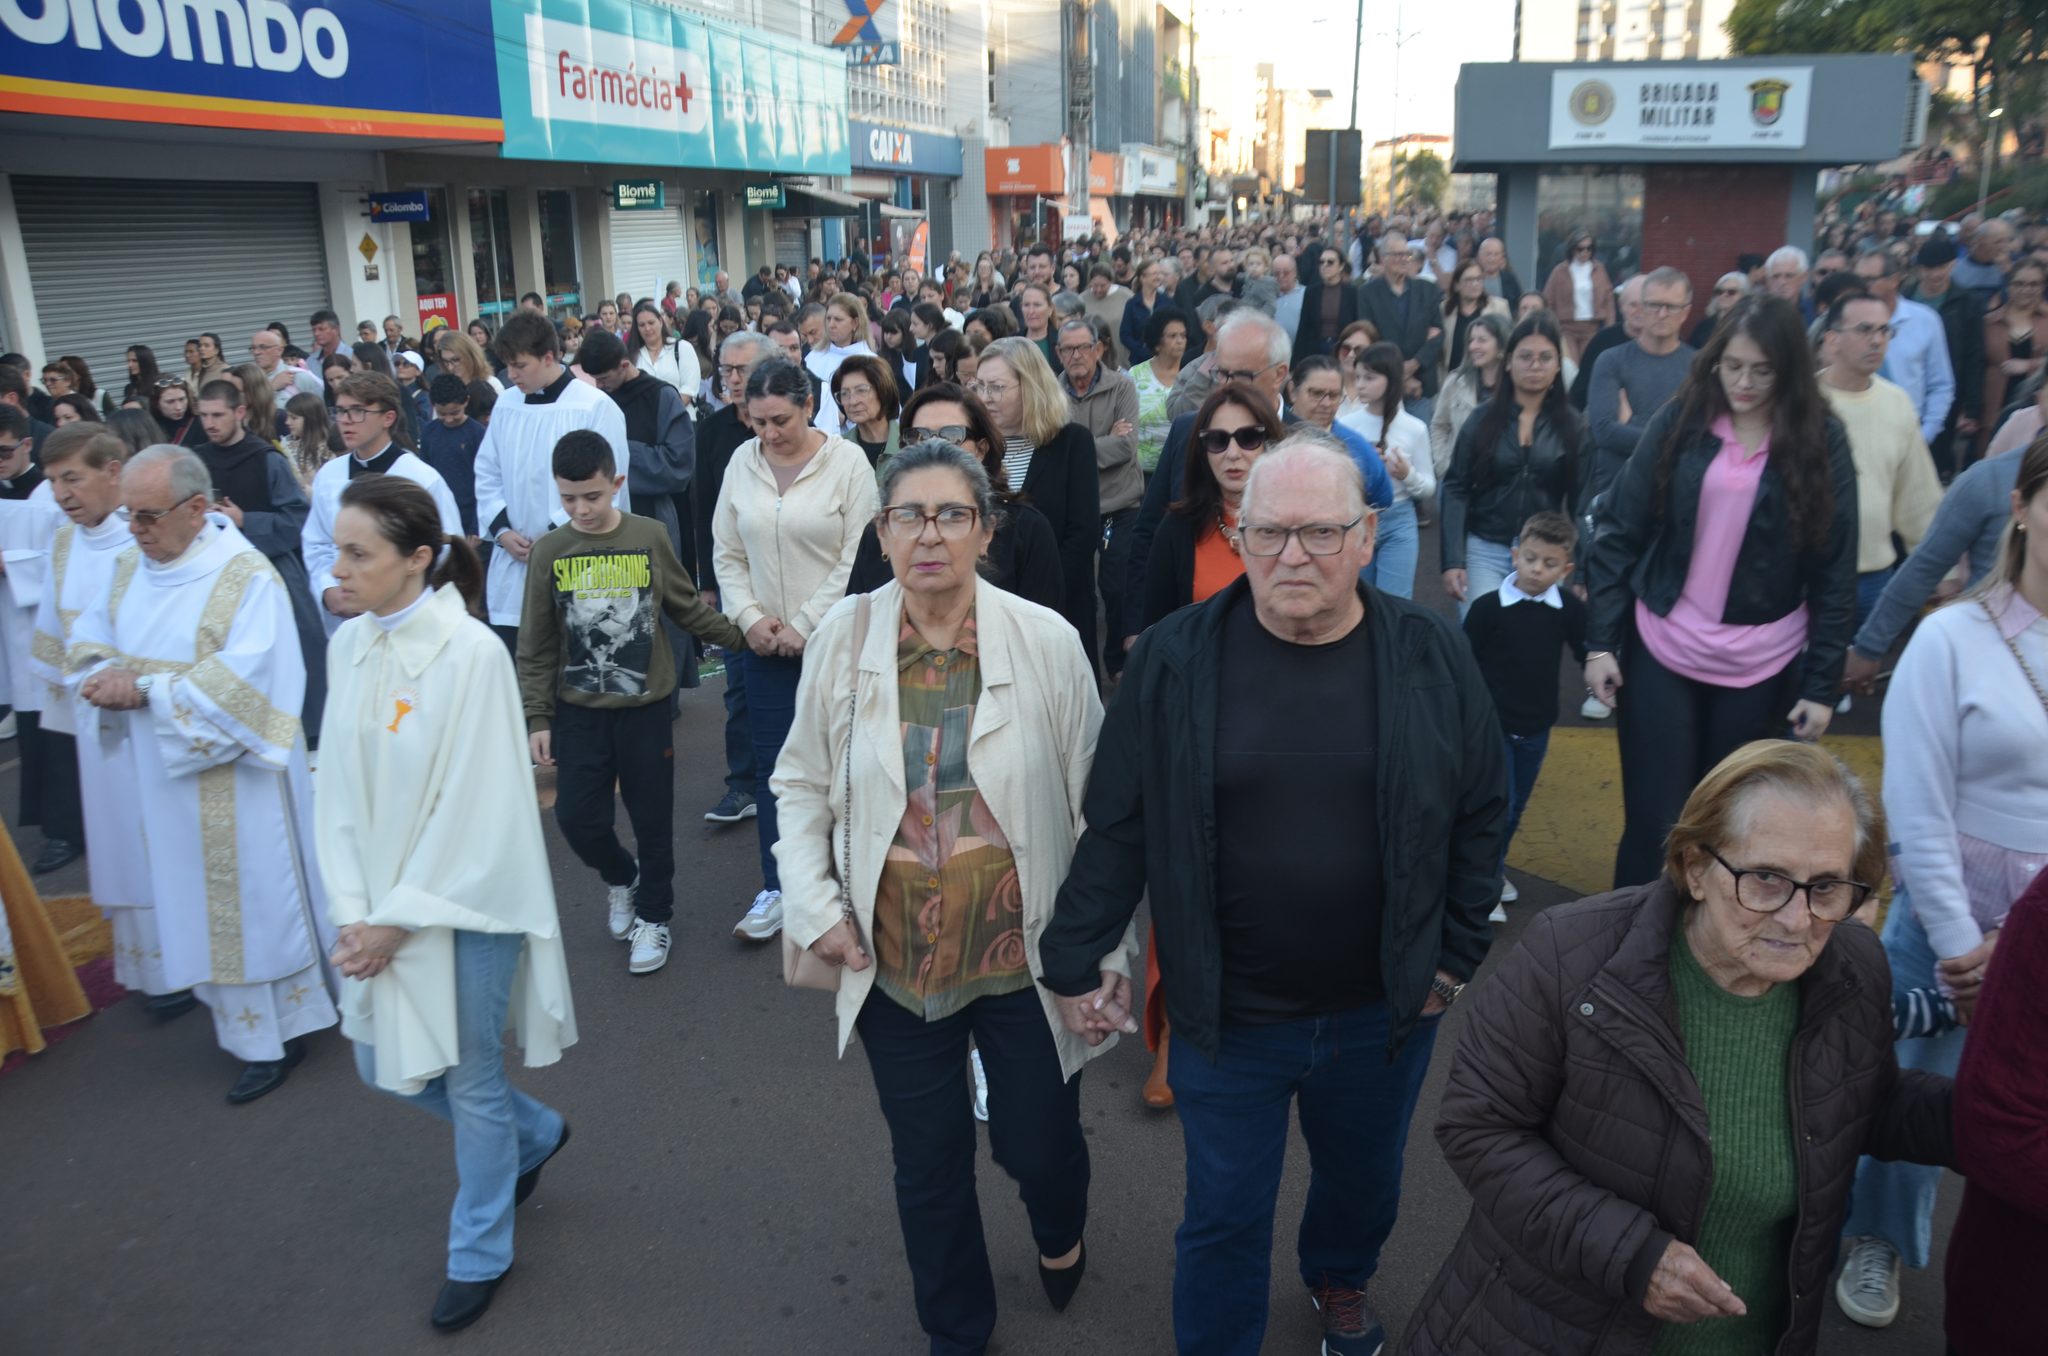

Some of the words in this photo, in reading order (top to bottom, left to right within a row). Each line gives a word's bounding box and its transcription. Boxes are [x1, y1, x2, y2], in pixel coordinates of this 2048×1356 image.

[1640, 82, 1719, 102] BRIGADA
[1640, 107, 1715, 127] MILITAR
[869, 128, 912, 165] CAIXA
[383, 202, 424, 213] Colombo
[419, 298, 434, 311] AQUI
[435, 297, 448, 309] TEM
[553, 554, 650, 592] SKATEBOARDING
